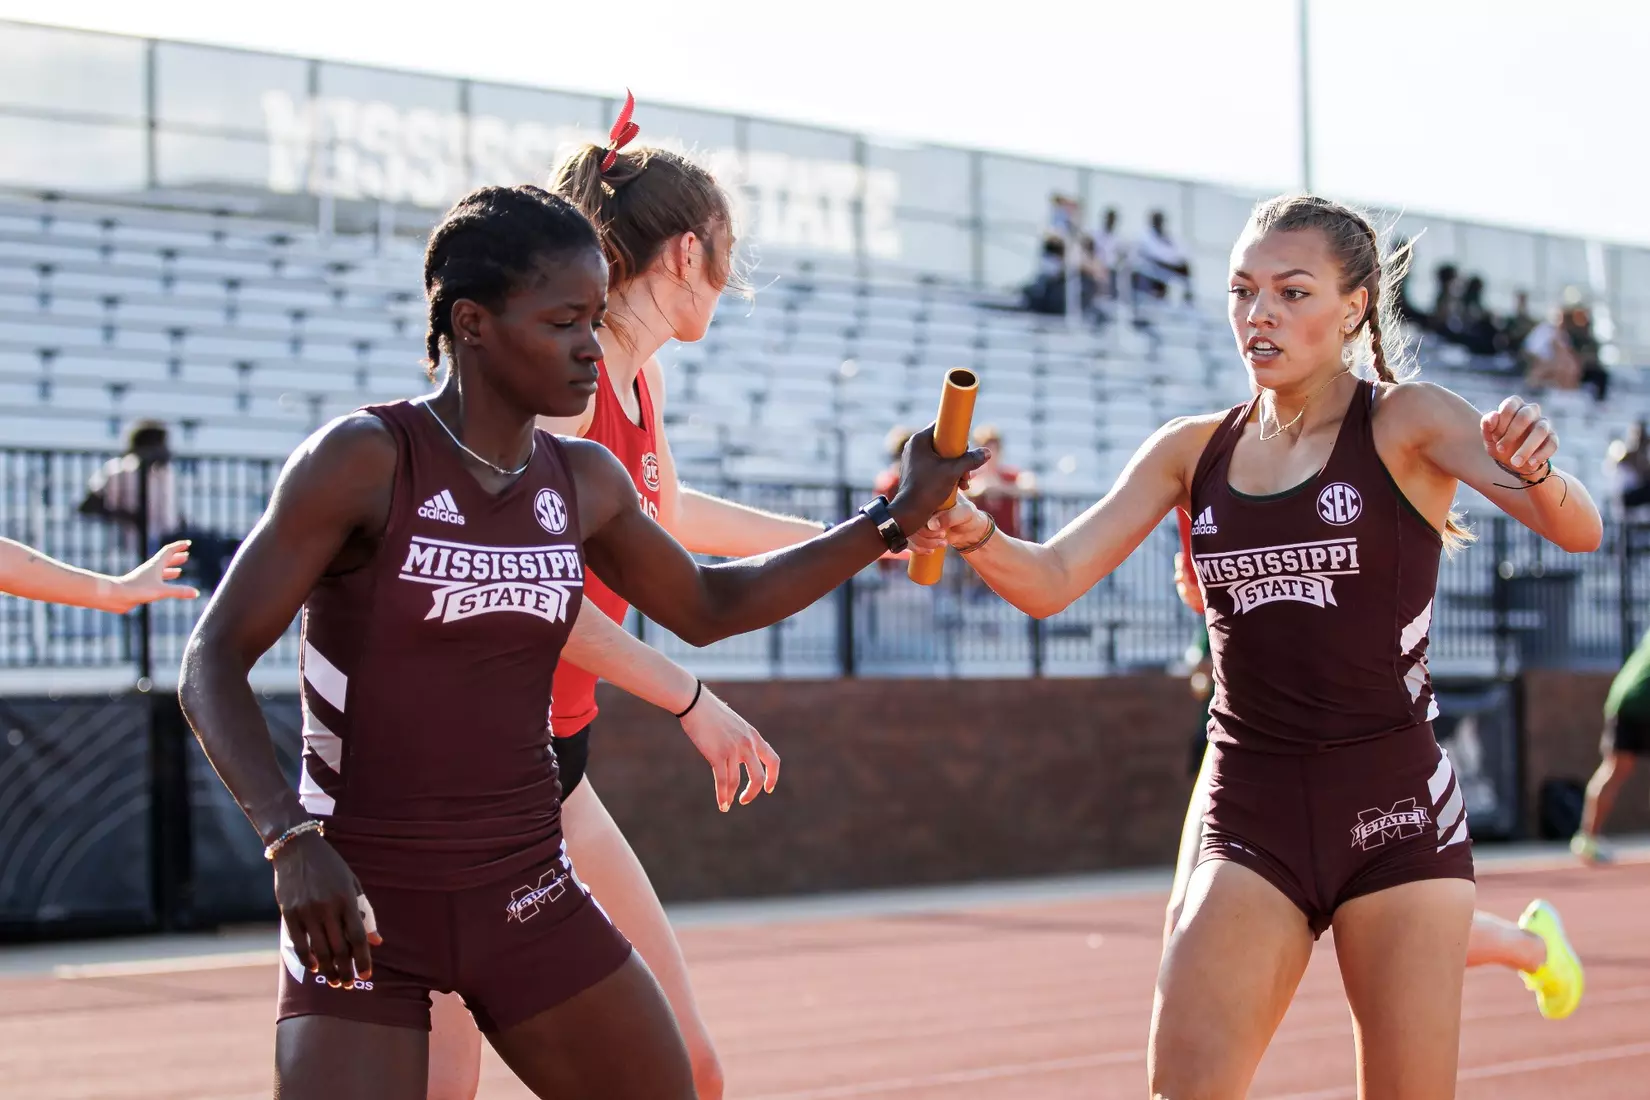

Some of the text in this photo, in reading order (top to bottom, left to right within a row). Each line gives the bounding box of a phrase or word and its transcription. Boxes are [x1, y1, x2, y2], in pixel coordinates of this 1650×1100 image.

[418, 505, 466, 526] adidas
[536, 491, 567, 533] SEC
[1319, 484, 1359, 523] SEC
[1191, 523, 1218, 536] adidas
[401, 543, 583, 581] MISSISSIPPI
[1196, 544, 1360, 583] MISSISSIPPI
[457, 587, 552, 614] STATE
[1244, 579, 1316, 605] STATE
[1364, 813, 1415, 835] STATE
[315, 974, 374, 991] aas
